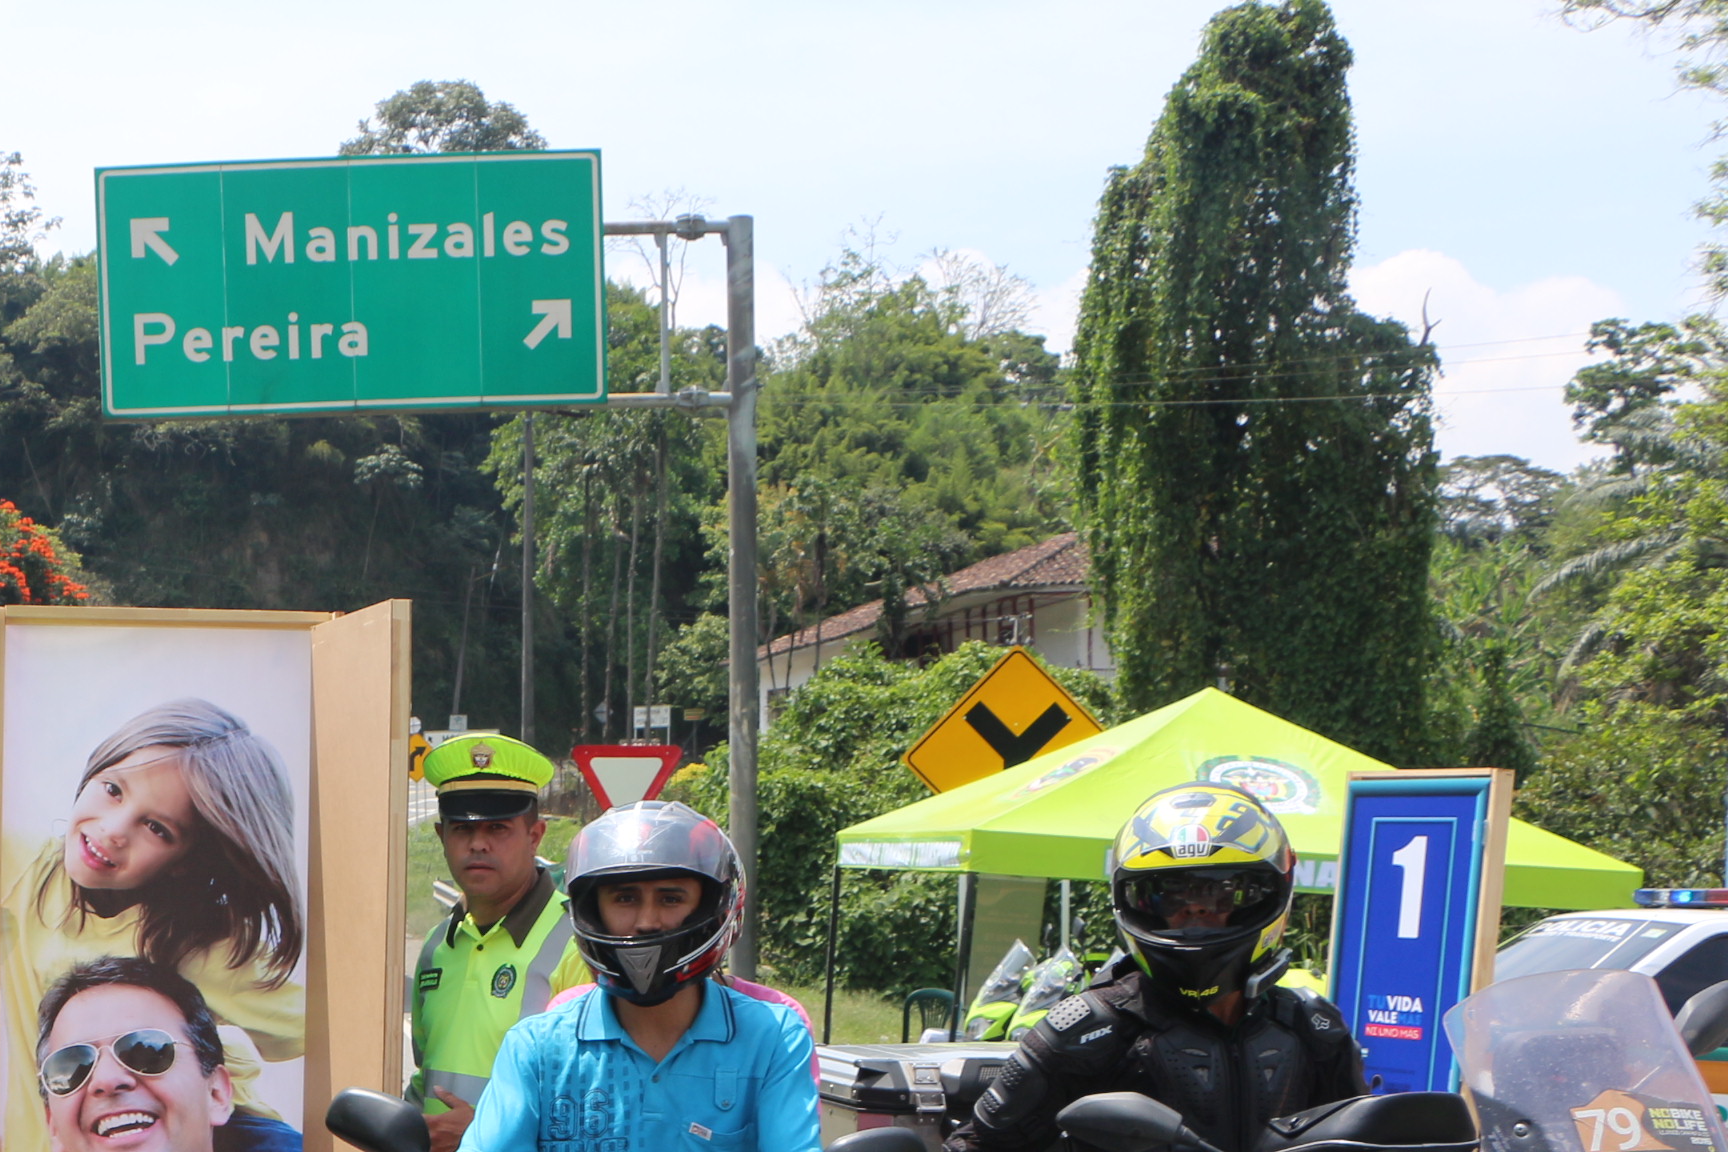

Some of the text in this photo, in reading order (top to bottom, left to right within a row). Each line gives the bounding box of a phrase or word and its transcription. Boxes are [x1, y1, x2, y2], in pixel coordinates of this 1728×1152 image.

[244, 210, 570, 266] Manizales
[133, 311, 369, 366] Pereira
[1391, 835, 1428, 939] 1
[1080, 1025, 1113, 1044] FOX
[1574, 1107, 1642, 1152] 79
